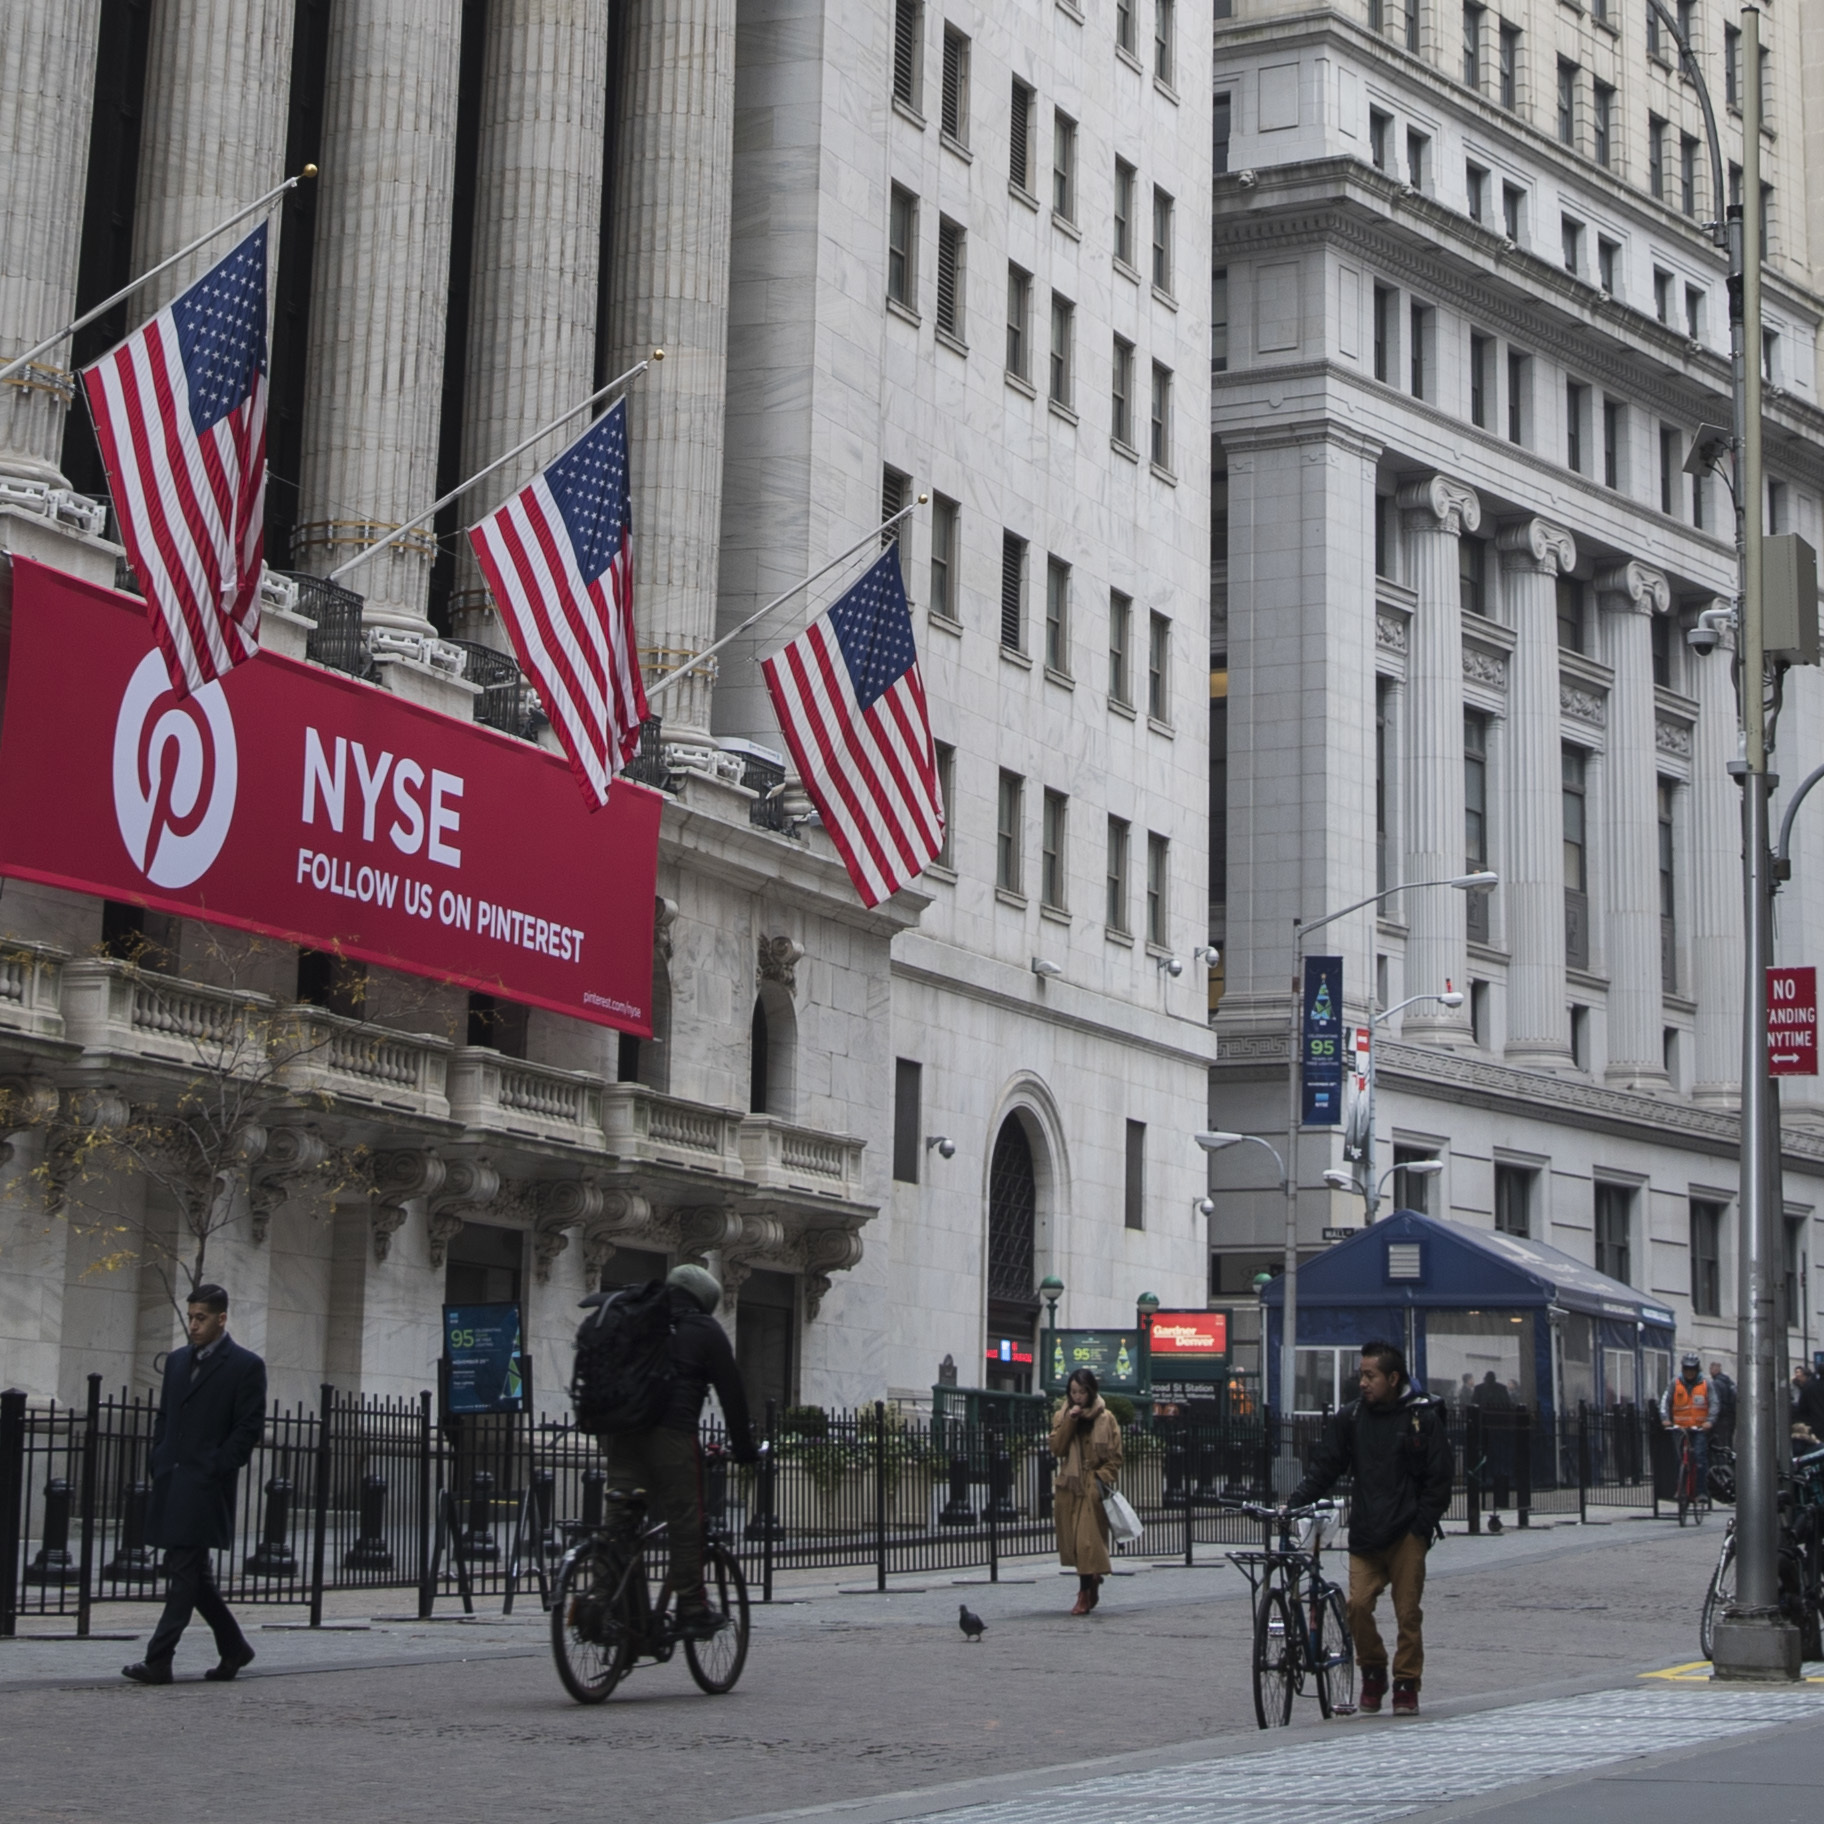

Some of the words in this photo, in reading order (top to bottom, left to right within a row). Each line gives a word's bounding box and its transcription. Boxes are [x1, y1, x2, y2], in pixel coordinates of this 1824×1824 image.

[301, 727, 466, 869] NYSE
[296, 847, 400, 910] FOLLOW
[403, 877, 433, 920] US
[438, 889, 472, 930] ON
[477, 901, 585, 965] PINTEREST
[1773, 979, 1796, 1001] NO
[583, 989, 642, 1020] pinterest.com/nyse
[1767, 1008, 1816, 1024] ANDING
[1311, 1039, 1335, 1055] 95
[1767, 1031, 1813, 1047] NYTIME
[451, 1329, 474, 1348] 95
[1153, 1325, 1197, 1336] Gardner
[1176, 1336, 1215, 1347] Denver
[1073, 1347, 1090, 1361] 95
[1151, 1383, 1171, 1392] road
[1172, 1383, 1182, 1392] St
[1185, 1383, 1214, 1392] Station
